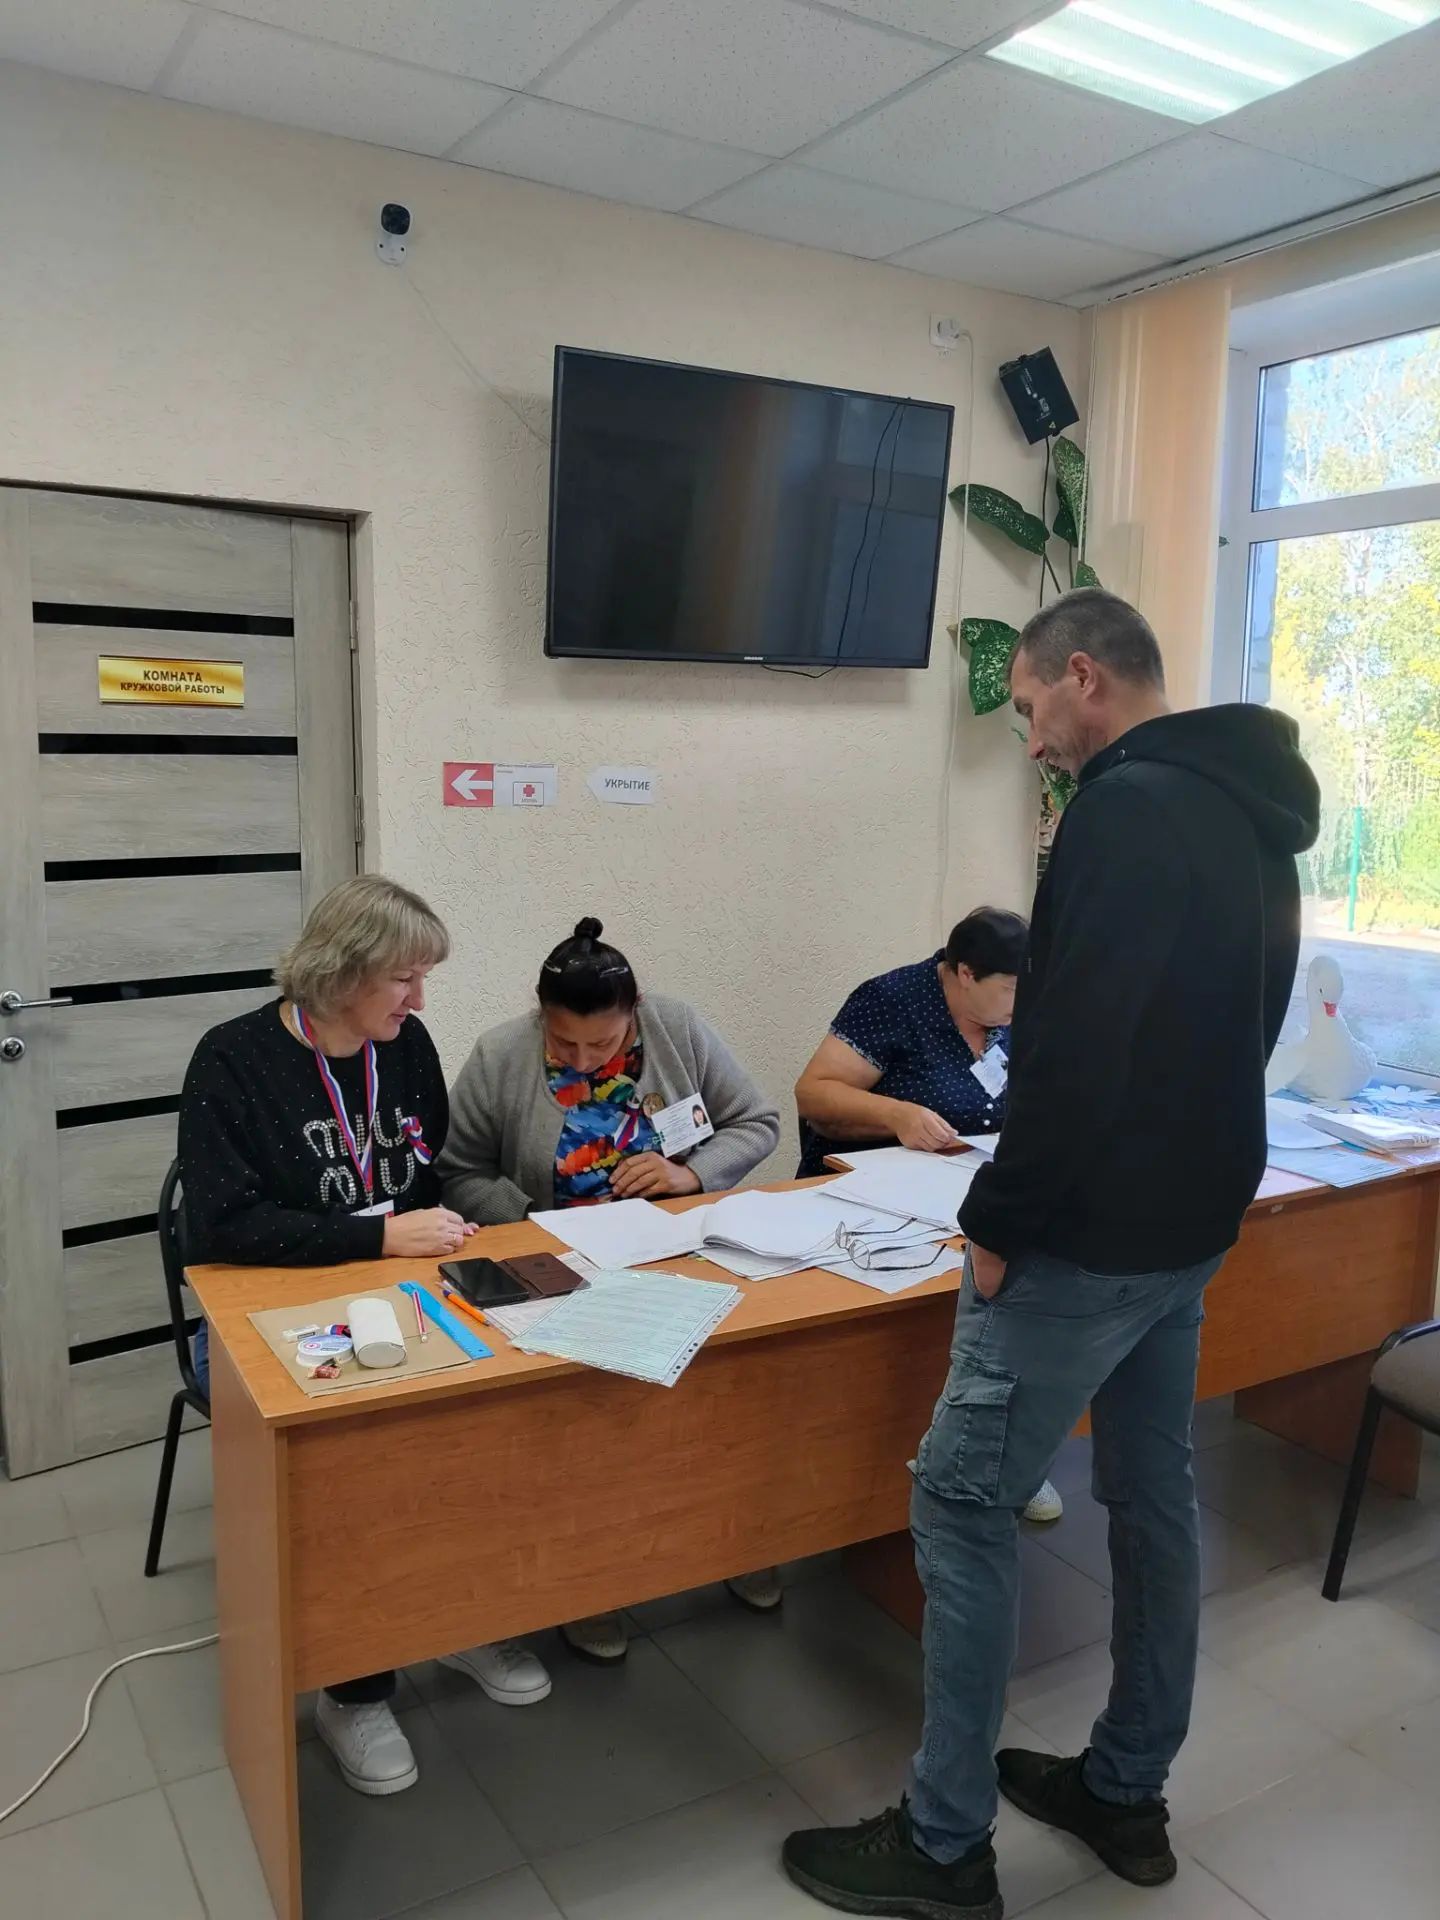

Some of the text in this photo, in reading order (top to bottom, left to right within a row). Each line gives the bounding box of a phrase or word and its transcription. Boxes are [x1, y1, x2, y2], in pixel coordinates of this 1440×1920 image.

[143, 670, 203, 682] КОМНАТА
[120, 682, 225, 694] КРУЖКОВОЙ РАБОТЫ
[604, 778, 651, 791] УКРЫТИЕ
